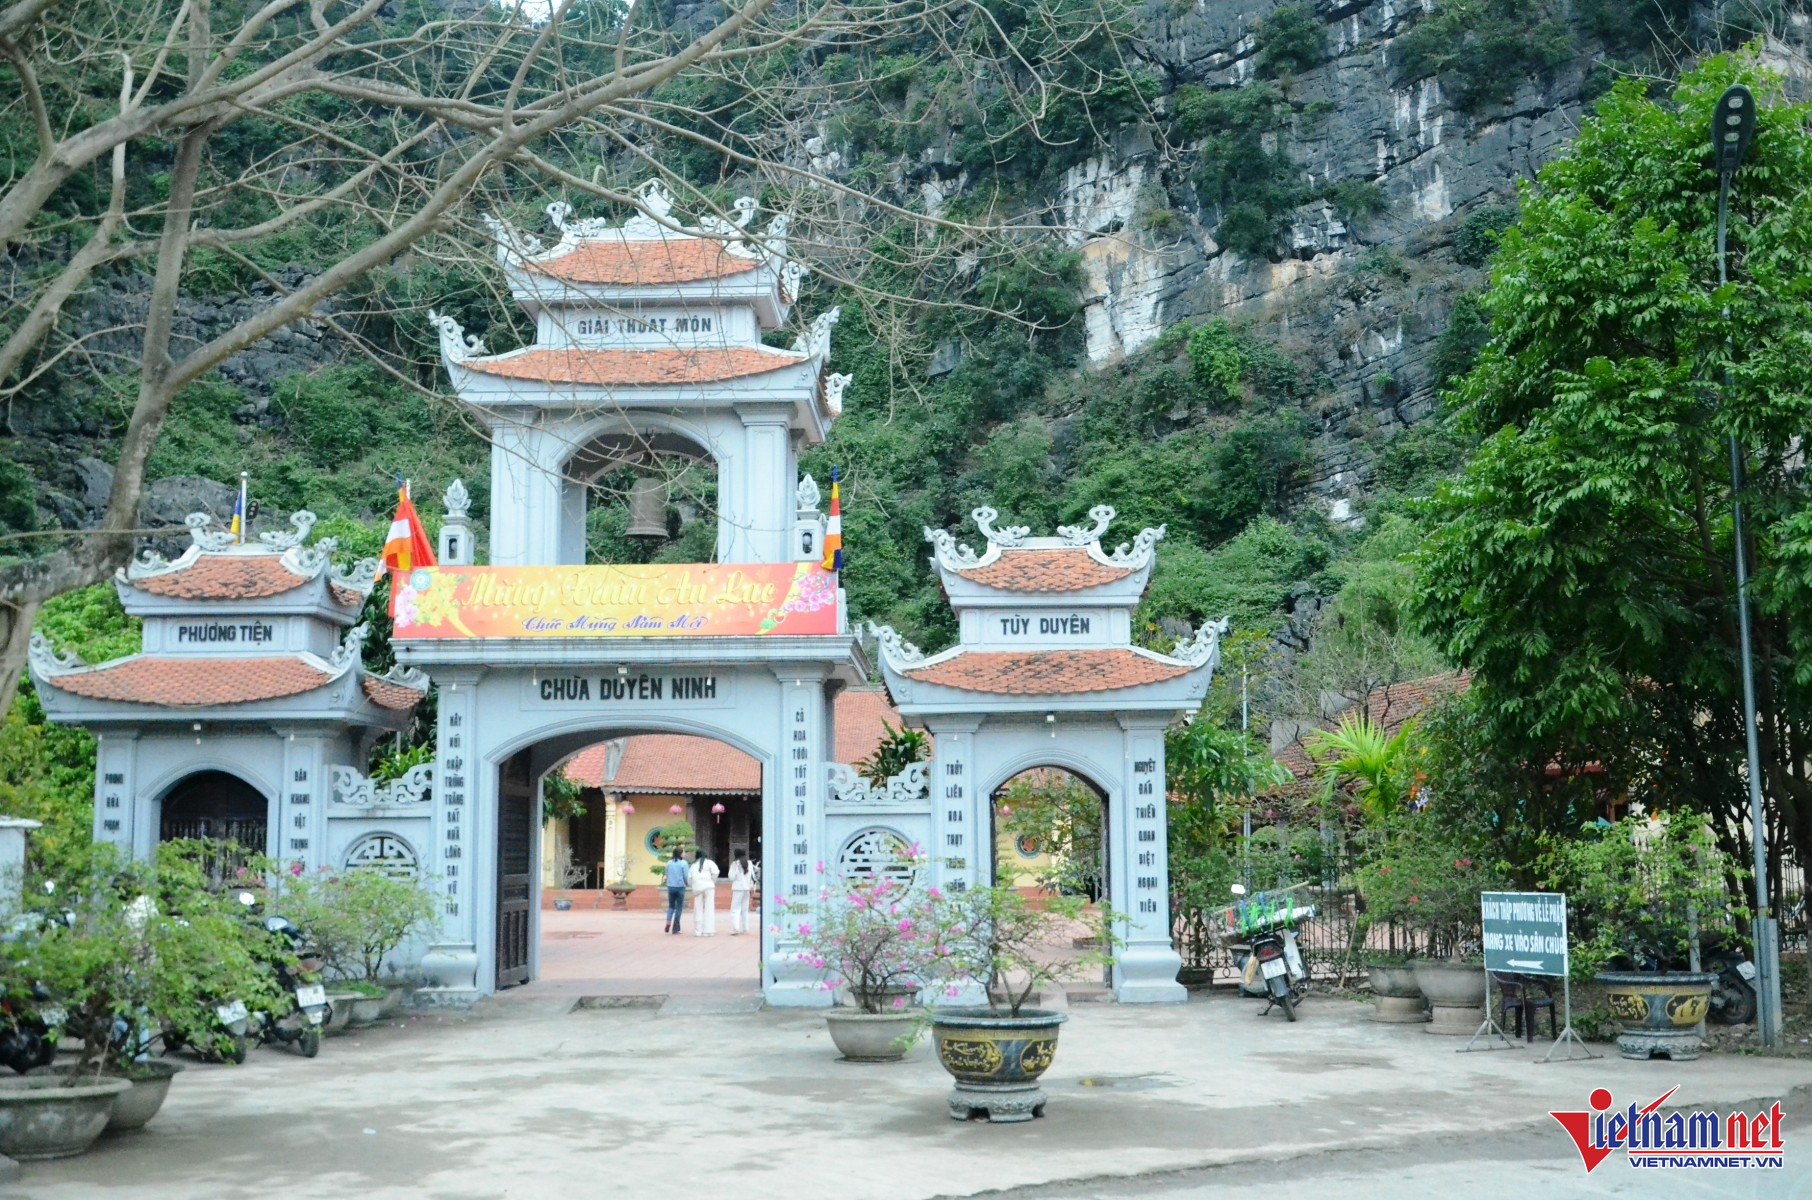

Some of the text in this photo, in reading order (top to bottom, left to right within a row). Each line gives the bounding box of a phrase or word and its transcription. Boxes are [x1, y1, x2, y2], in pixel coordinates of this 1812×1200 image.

[676, 315, 711, 332] MÔN
[460, 572, 548, 614] Mừng
[657, 571, 707, 605] An
[716, 570, 776, 611] Lạc
[566, 615, 619, 633] Mừng
[622, 615, 664, 630] Năm
[667, 615, 708, 630] Mới
[1000, 613, 1090, 635] TÙY DUYÊN
[179, 620, 272, 646] PHƯƠNG TIỆN
[540, 674, 716, 700] CHÙA DUYÊN NINH
[793, 730, 806, 741] HOA
[946, 784, 963, 799] LIÊN
[948, 810, 963, 822] HOA
[796, 824, 804, 836] BI
[1138, 830, 1155, 842] QUAN
[1139, 850, 1155, 867] BIỆT
[447, 865, 458, 877] SOI
[792, 884, 808, 895] SINH
[1484, 929, 1565, 955] MANG XE VÀO SÂN CHÙA
